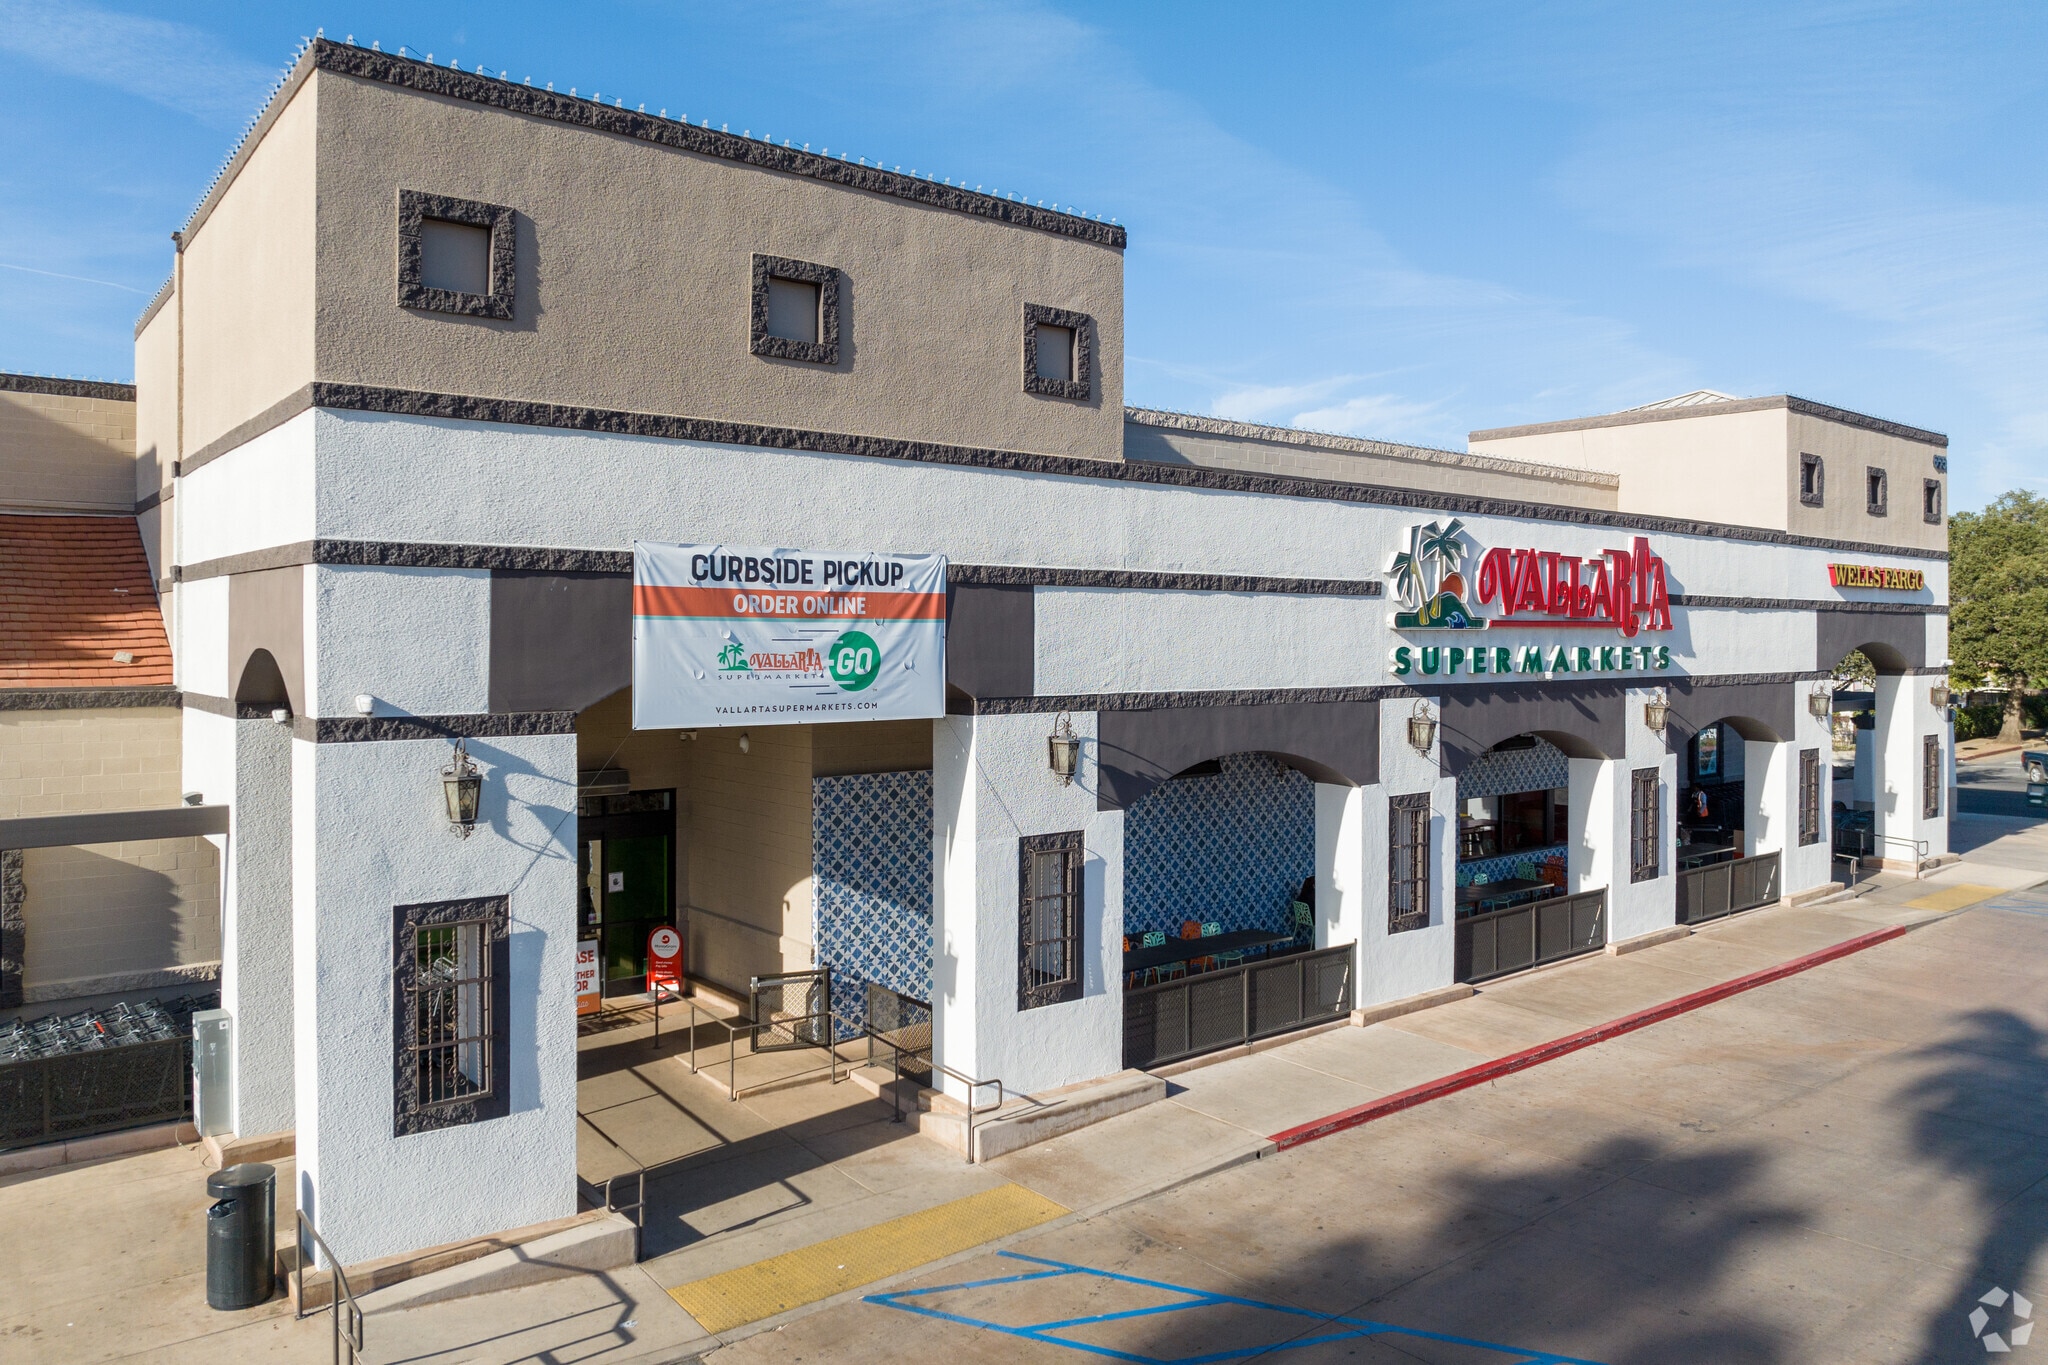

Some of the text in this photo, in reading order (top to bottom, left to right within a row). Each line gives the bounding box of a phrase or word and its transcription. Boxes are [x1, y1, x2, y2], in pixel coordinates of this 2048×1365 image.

[691, 554, 904, 587] CURBSIDE PICKUP
[1833, 563, 1924, 591] WELLS FARGO
[733, 593, 866, 616] ORDER ONLINE
[836, 647, 873, 676] GO
[1391, 645, 1670, 676] SUPERMARKETS
[716, 702, 878, 714] VALLARTASUPERMARKETS.COM
